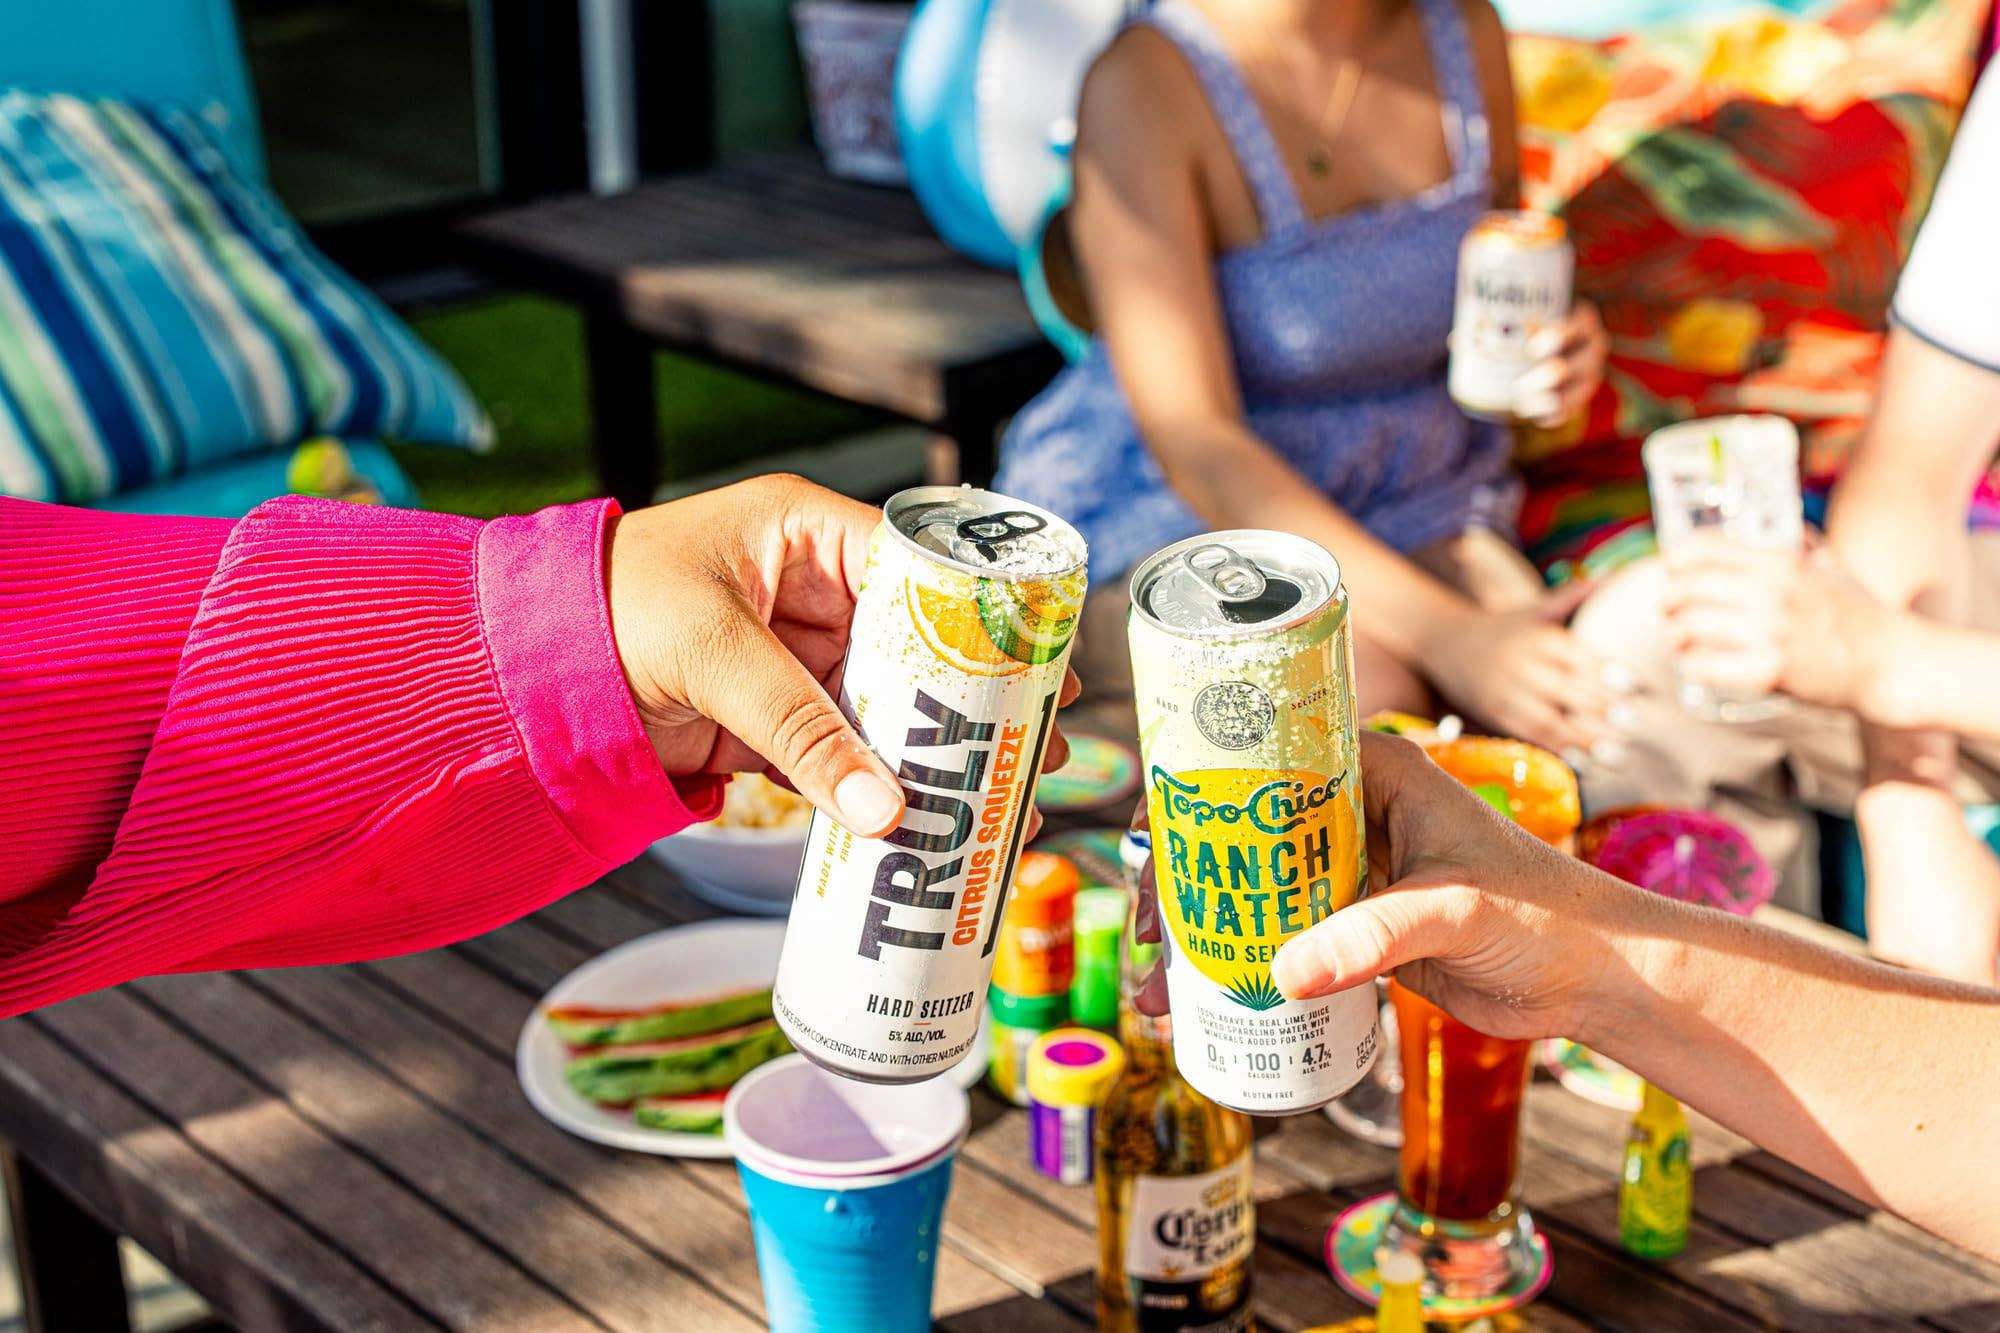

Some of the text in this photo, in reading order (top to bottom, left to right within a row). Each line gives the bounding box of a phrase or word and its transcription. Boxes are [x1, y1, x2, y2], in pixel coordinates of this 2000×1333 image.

[1151, 765, 1244, 827] Topo
[1246, 768, 1347, 835] Chico
[858, 688, 996, 961] TRULY
[952, 723, 1028, 946] CITRUS SQUEEZE
[816, 859, 831, 898] MADE
[825, 820, 840, 855] WITH
[839, 832, 853, 862] FROM
[1168, 826, 1331, 889] RANCH
[1174, 876, 1334, 937] WATER
[1188, 933, 1236, 961] HARD
[866, 990, 974, 1018] HARD SELTZER
[1260, 1018, 1282, 1027] REAL
[1285, 1014, 1306, 1025] LIME
[1308, 1005, 1330, 1021] JUICE
[888, 1030, 903, 1041] 5%
[1247, 1037, 1277, 1046] ADDED
[1280, 1035, 1297, 1045] FOR
[1300, 1026, 1325, 1041] TASTE
[1279, 1023, 1308, 1035] WATER
[1310, 1015, 1330, 1029] WITH
[811, 1029, 868, 1061] CONCENTRATE
[868, 1051, 888, 1064] AND
[889, 1054, 911, 1065] WITH
[911, 1053, 938, 1065] OTHER
[1245, 1052, 1281, 1071] 100
[1301, 1042, 1332, 1066] 4.7%
[1302, 1065, 1317, 1075] ALC.
